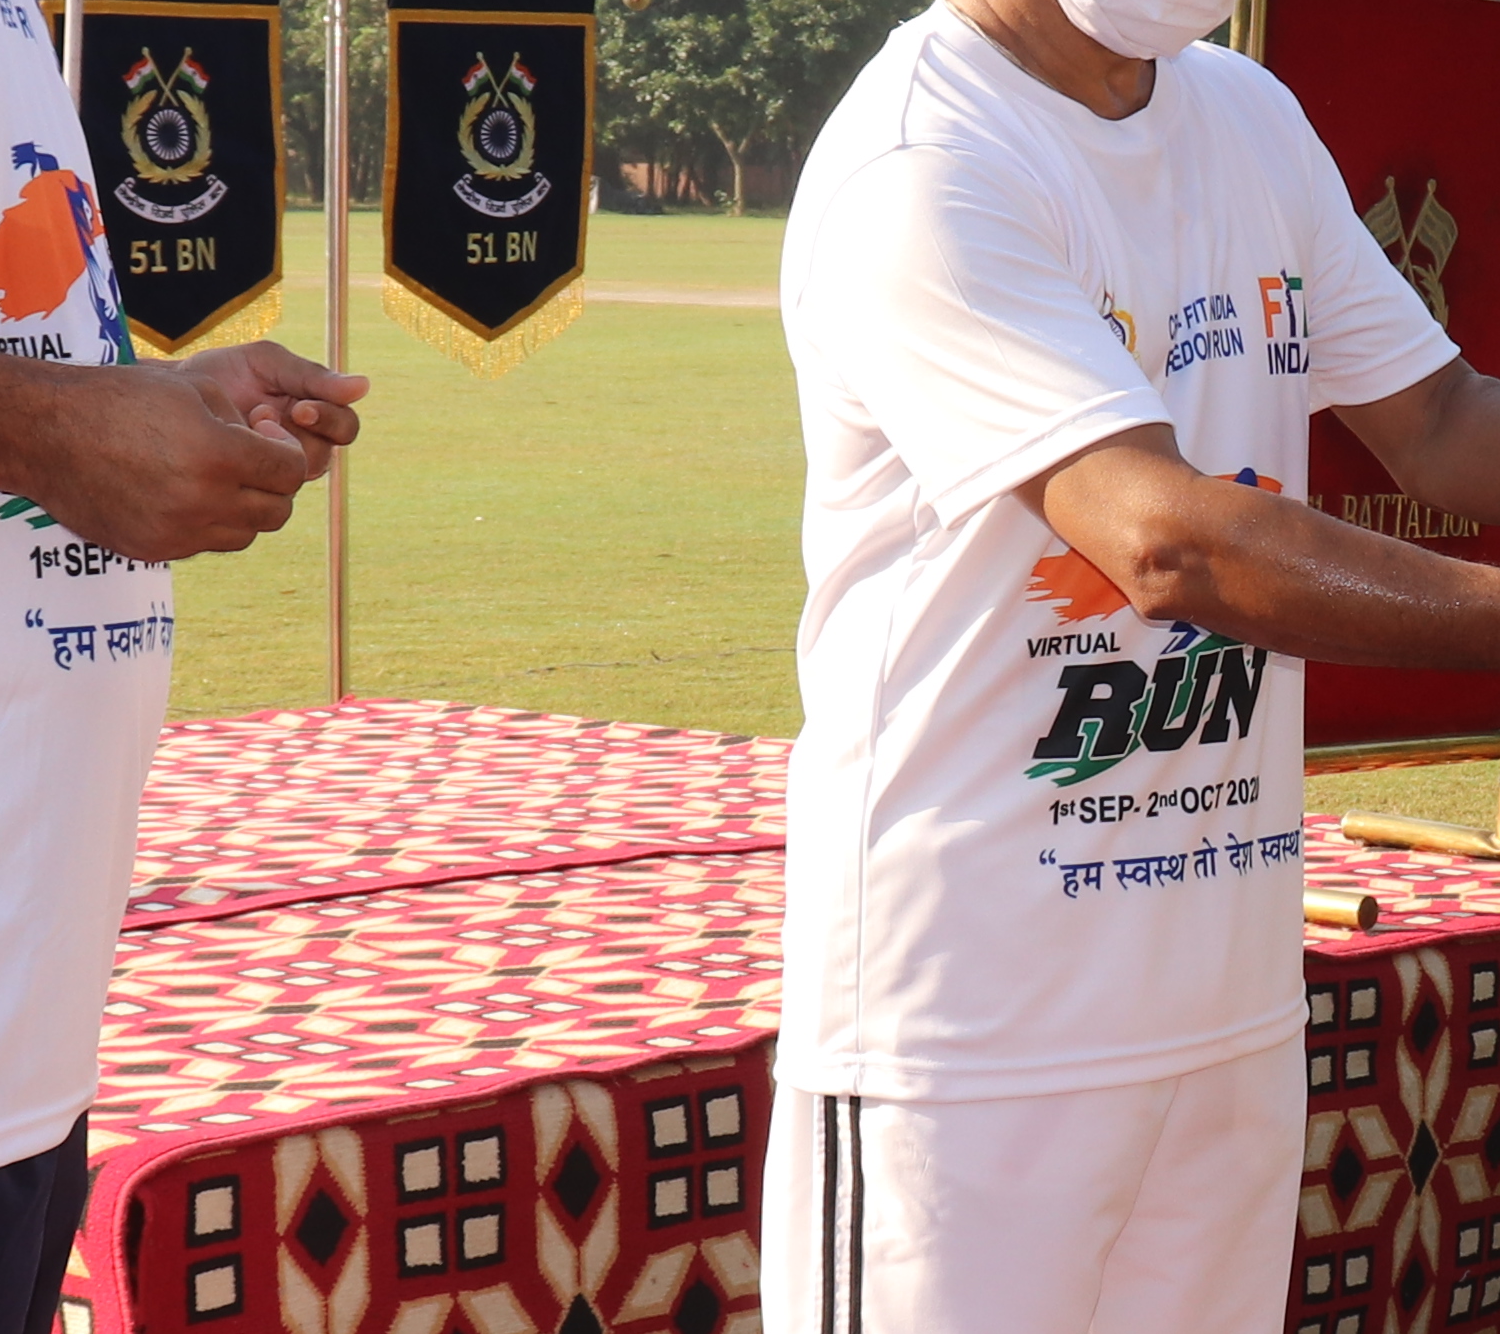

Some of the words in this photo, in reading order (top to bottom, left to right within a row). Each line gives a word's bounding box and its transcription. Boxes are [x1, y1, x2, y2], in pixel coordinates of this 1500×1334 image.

[129, 239, 168, 274] 51
[176, 237, 216, 271] BN
[466, 232, 498, 264] 51
[506, 231, 538, 262] BN
[1212, 327, 1245, 358] RUN
[29, 545, 60, 579] 1st
[1027, 631, 1121, 658] VIRTUAL
[1032, 647, 1268, 759] RUN
[1049, 799, 1076, 825] 1st
[1146, 789, 1178, 818] 2nd
[1180, 782, 1223, 814] OCT
[1112, 853, 1188, 890] स्वस्थ
[1193, 837, 1219, 878] तो
[1224, 832, 1254, 876] देश
